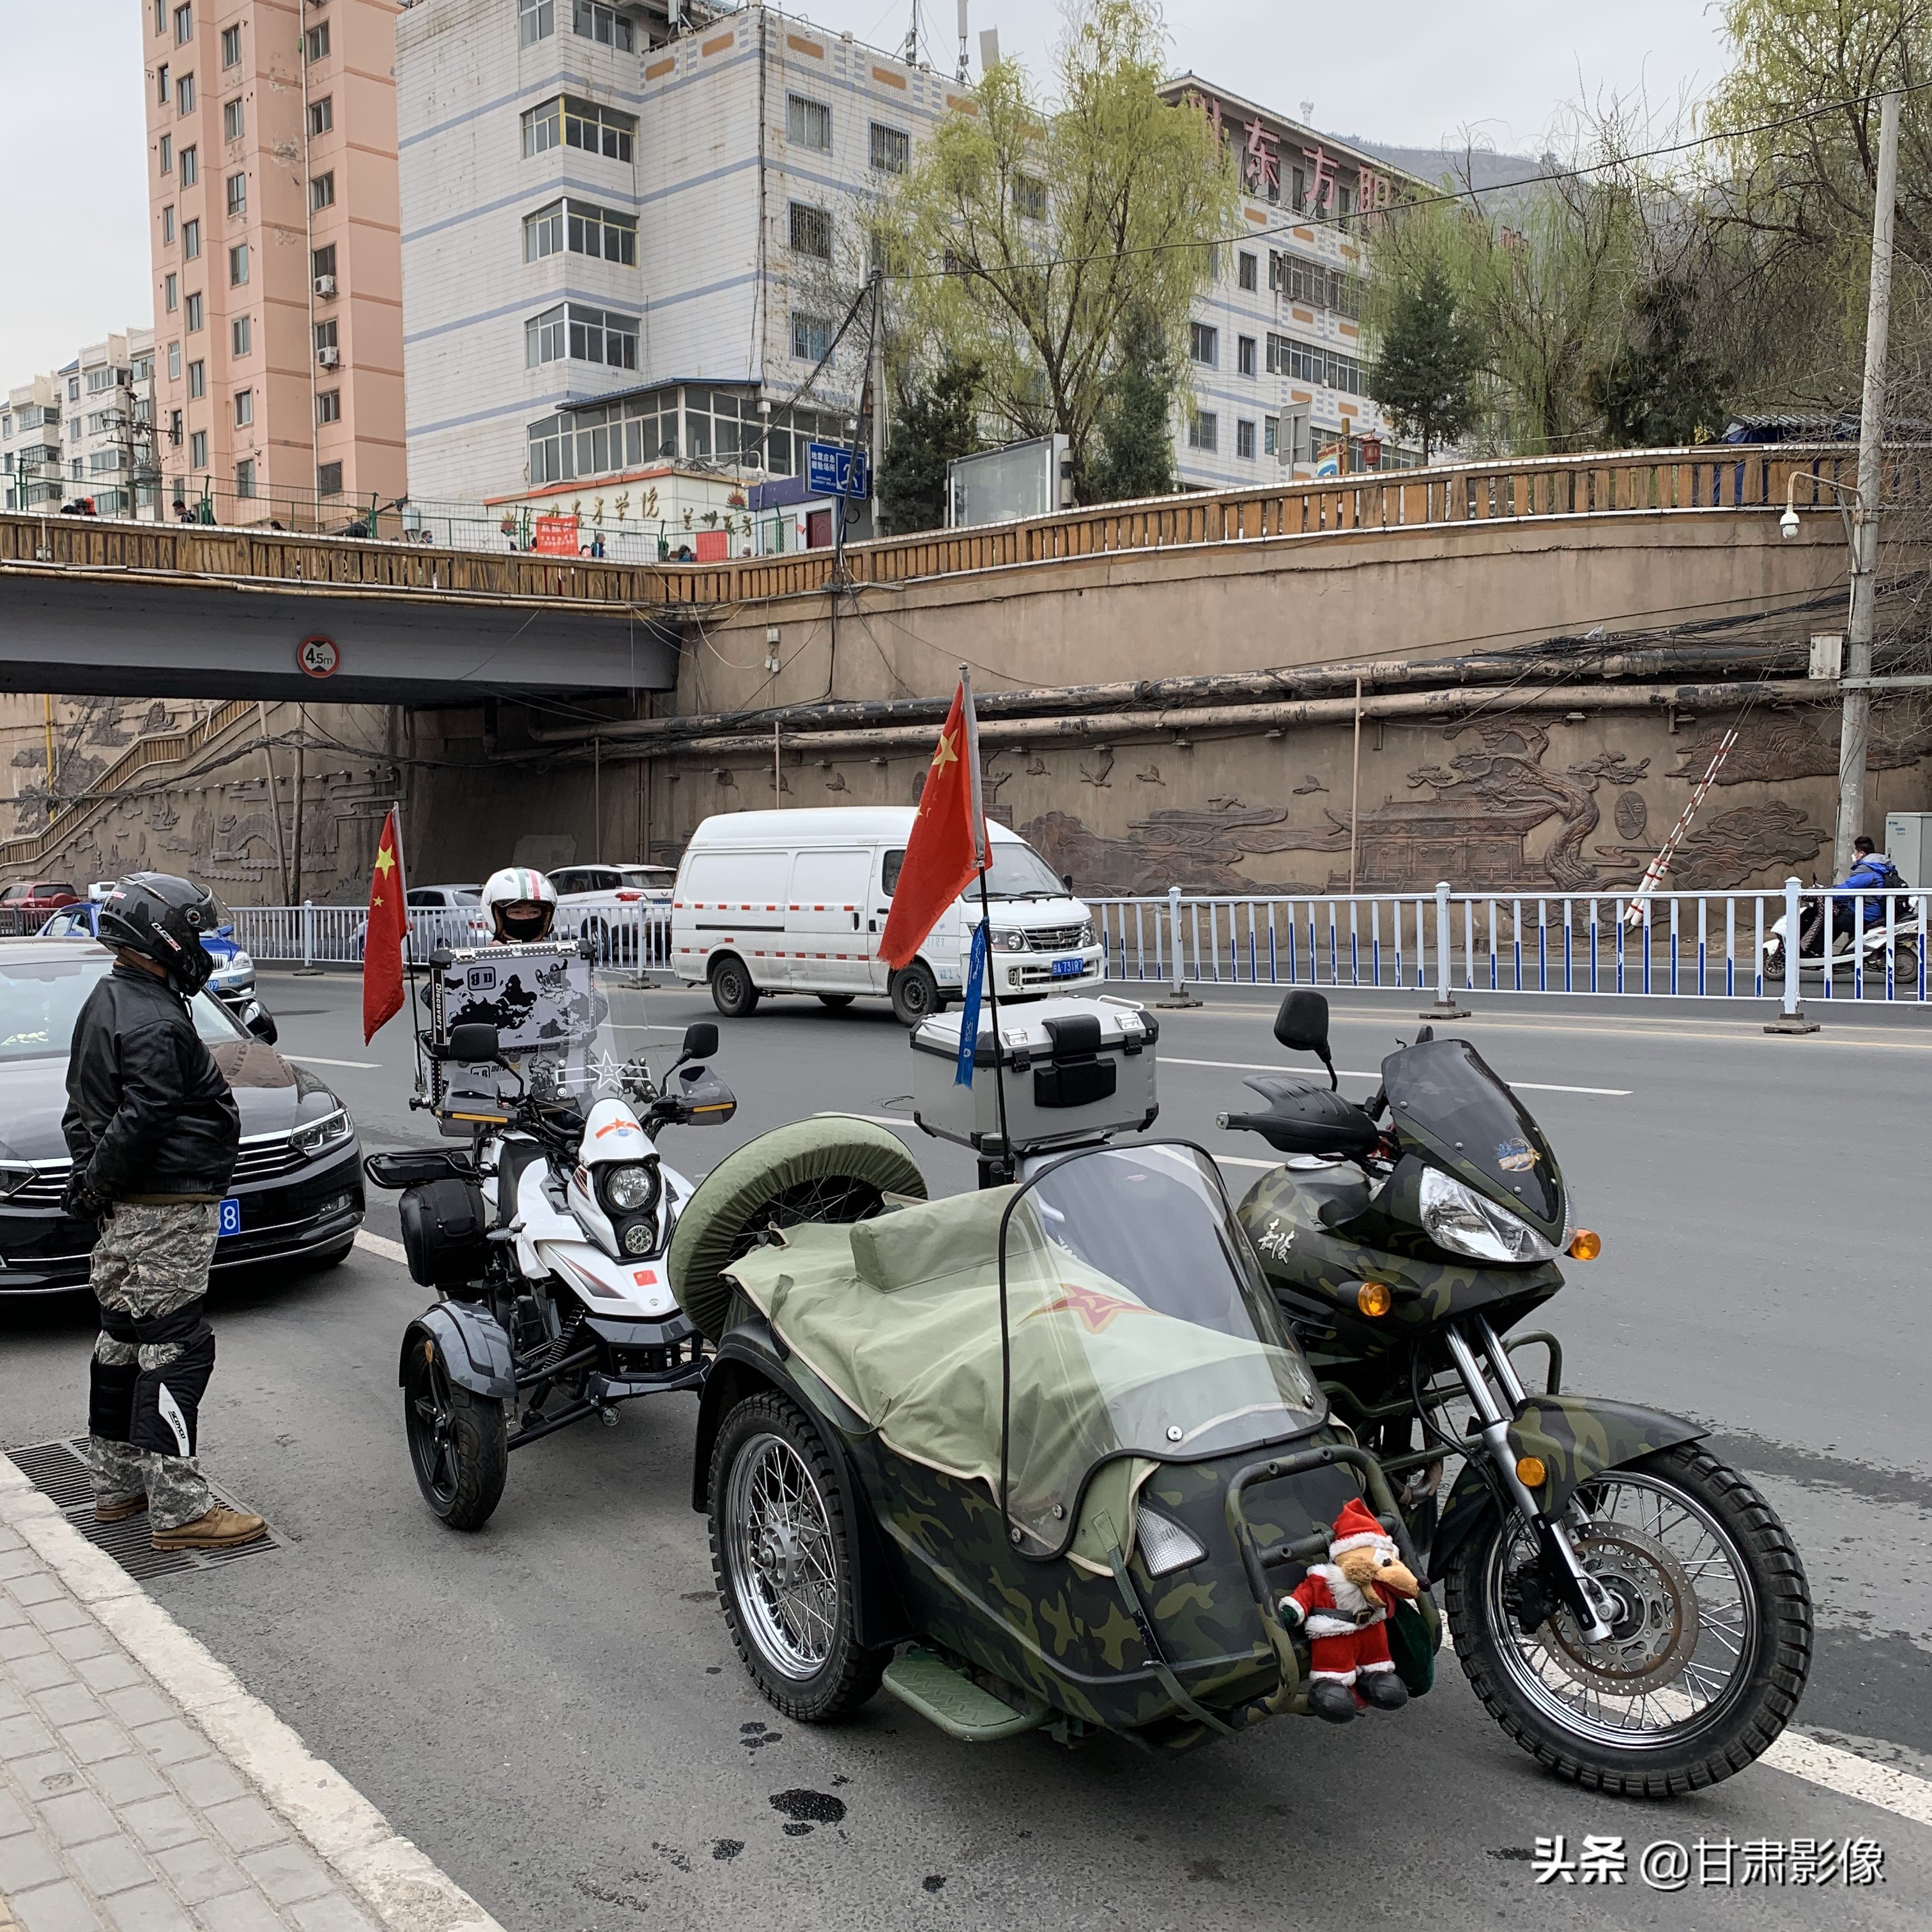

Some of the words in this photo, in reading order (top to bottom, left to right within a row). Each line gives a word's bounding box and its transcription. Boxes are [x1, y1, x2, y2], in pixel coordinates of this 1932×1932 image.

[811, 450, 835, 463] 地震应急
[305, 647, 333, 664] 4.5m
[224, 1206, 236, 1230] 8
[1257, 1218, 1295, 1264] 嘉陵
